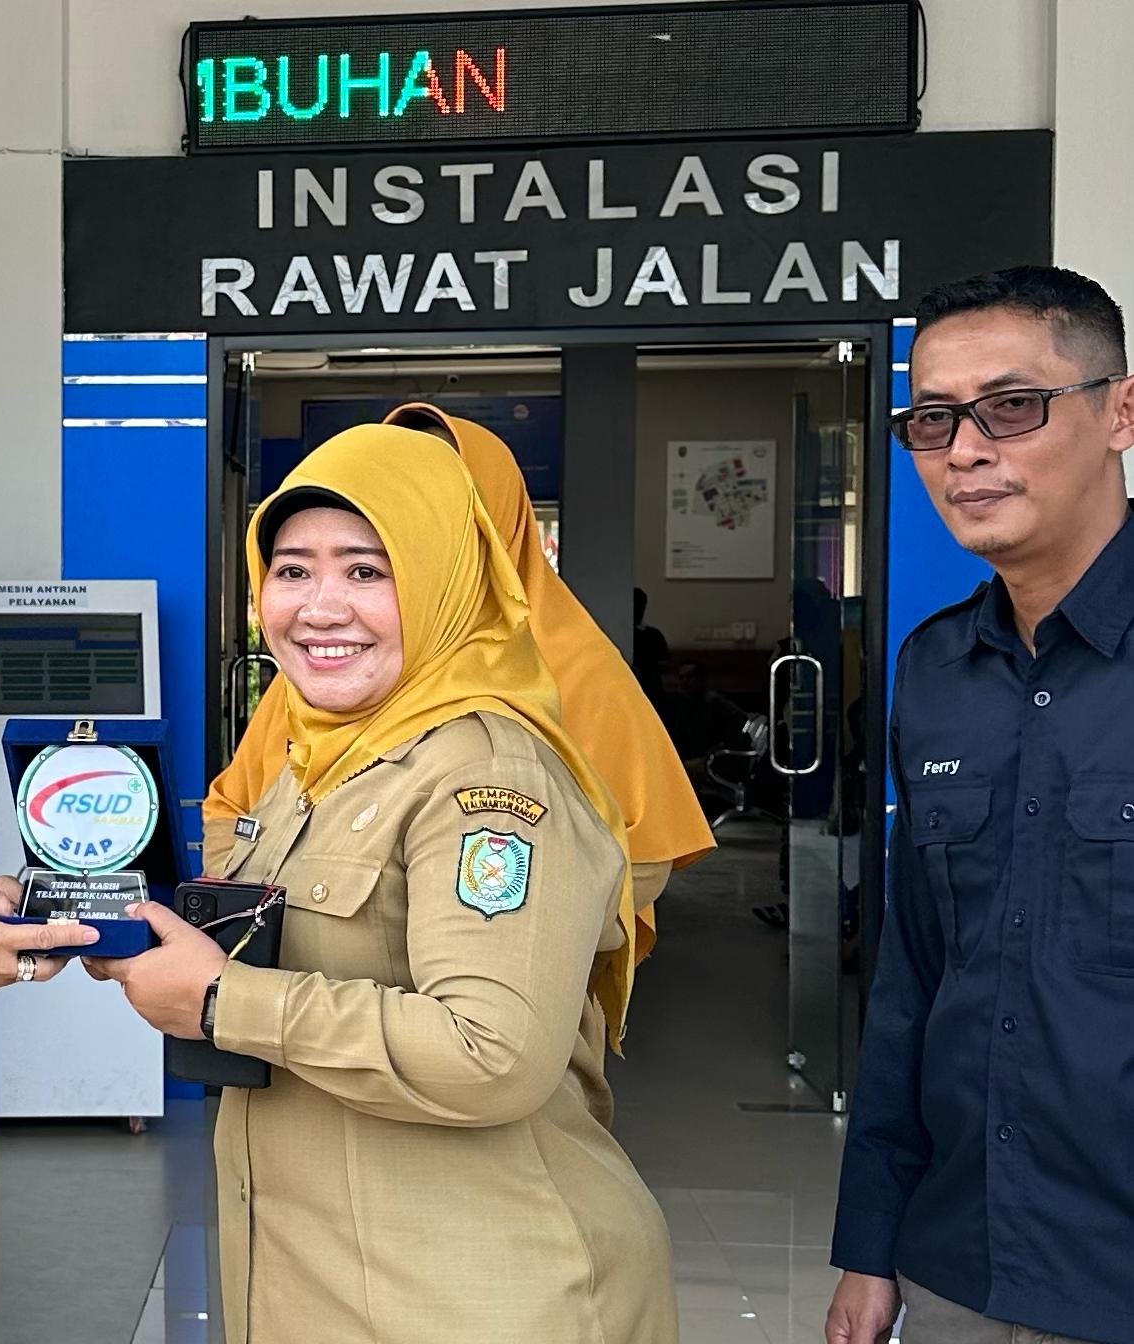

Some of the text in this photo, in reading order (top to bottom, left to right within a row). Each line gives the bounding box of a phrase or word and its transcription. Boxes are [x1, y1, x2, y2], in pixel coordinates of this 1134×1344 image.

[257, 150, 839, 229] INSTALASI
[200, 239, 900, 317] RAWAT JALAN
[36, 585, 87, 593] ANTRIAN
[8, 598, 76, 606] PELAYANAN
[922, 759, 961, 776] Ferry
[55, 793, 133, 814] RSUD
[469, 789, 535, 809] PEMPROV
[464, 799, 538, 821] KALIMANTAN BARAT
[58, 836, 113, 857] SIAP
[50, 881, 120, 891] TERIMA KASIH
[35, 890, 135, 901] TELAH BERKUNJUNG
[77, 901, 92, 909] KE
[78, 912, 119, 920] SAMBAS
